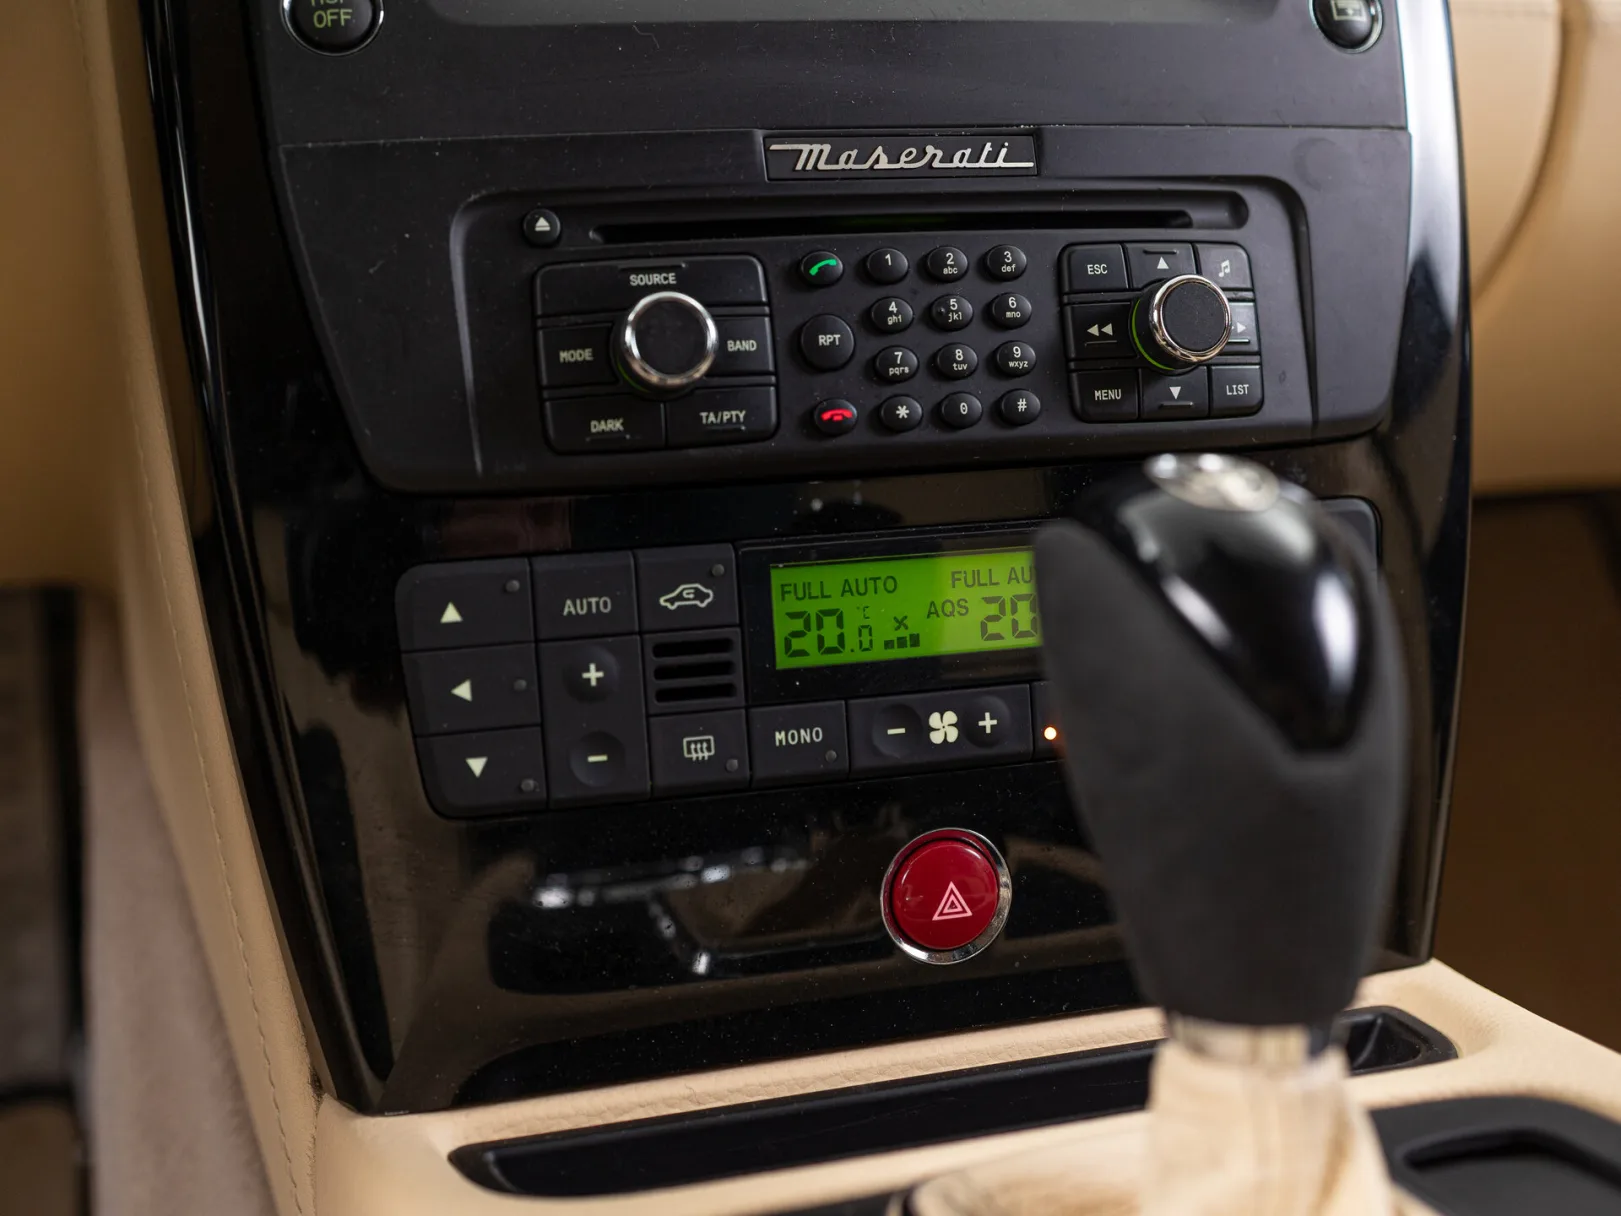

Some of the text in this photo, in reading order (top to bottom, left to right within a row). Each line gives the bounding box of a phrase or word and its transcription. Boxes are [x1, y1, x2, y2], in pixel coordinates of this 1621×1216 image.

[313, 9, 353, 28] OFF
[769, 141, 1034, 171] Maserati
[884, 254, 893, 266] 1
[946, 252, 955, 265] 2
[1003, 251, 1012, 264] 3
[942, 265, 958, 275] abc
[1001, 263, 1016, 273] def
[1087, 263, 1108, 275] ESC
[629, 272, 677, 286] SOURCE
[888, 301, 898, 314] 4
[949, 299, 958, 311] 5
[1008, 297, 1017, 309] 6
[887, 314, 902, 325] ghi
[948, 311, 962, 321] jkl
[1005, 310, 1021, 319] mno
[727, 339, 758, 352] BAND
[818, 333, 841, 346] RPT
[559, 348, 594, 363] MODE
[894, 351, 903, 364] 7
[954, 348, 964, 361] 8
[1012, 346, 1022, 359] 9
[888, 365, 909, 376] pqrs
[952, 361, 968, 371] tuv
[1008, 359, 1029, 369] wxyz
[1094, 389, 1122, 401] MENU
[1226, 384, 1249, 396] LIST
[699, 409, 746, 425] TA/PTY
[590, 417, 624, 433] DARK
[951, 565, 1034, 589] FULL AU
[780, 575, 898, 602] FULL AUTO
[563, 596, 612, 616] AUTO
[926, 598, 970, 620] AQS
[774, 727, 823, 747] MONO
